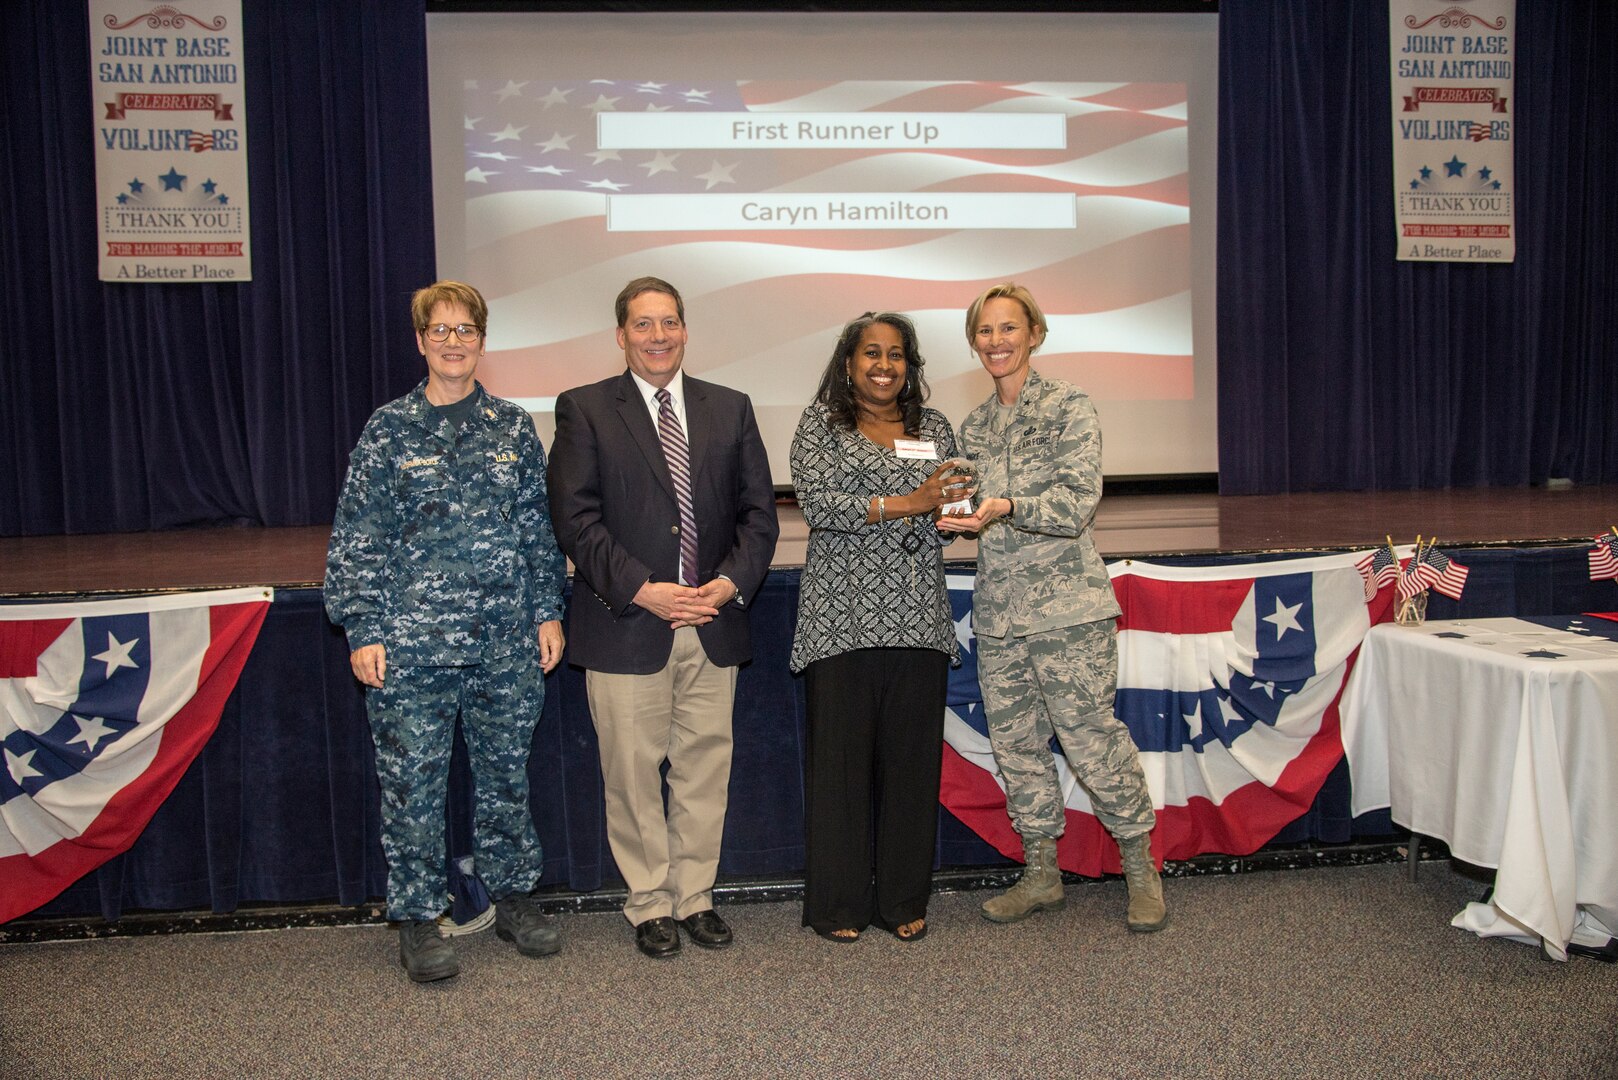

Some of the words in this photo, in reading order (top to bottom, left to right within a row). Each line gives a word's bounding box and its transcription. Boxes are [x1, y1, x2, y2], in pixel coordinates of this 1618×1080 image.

[102, 36, 168, 57] JOINT
[176, 37, 230, 58] BASE
[1402, 35, 1456, 54] JOINT
[1462, 36, 1508, 55] BASE
[99, 62, 144, 83] SAN
[150, 63, 238, 84] ANTONIO
[1398, 59, 1435, 78] SAN
[1440, 60, 1511, 79] ANTONIO
[124, 94, 215, 109] CELEBRATES
[1417, 89, 1494, 102] CELEBRATES
[731, 120, 788, 140] First
[797, 120, 894, 140] Runner
[903, 121, 939, 144] Up
[1399, 119, 1510, 141] VOLUNTRS
[101, 128, 239, 152] VOLUNTRS
[1409, 197, 1464, 211] THANK
[1468, 198, 1502, 211] YOU
[117, 213, 186, 227] THANK
[191, 213, 230, 228] YOU
[741, 202, 818, 226] Caryn
[828, 201, 949, 221] Hamilton
[110, 243, 132, 255] FOR
[180, 243, 200, 255] THE
[1409, 244, 1420, 257] A
[1423, 244, 1464, 258] Better
[1468, 245, 1502, 258] Place
[117, 264, 130, 278] A
[135, 264, 187, 278] Better
[192, 264, 235, 278] Place
[1022, 440, 1032, 449] AIR
